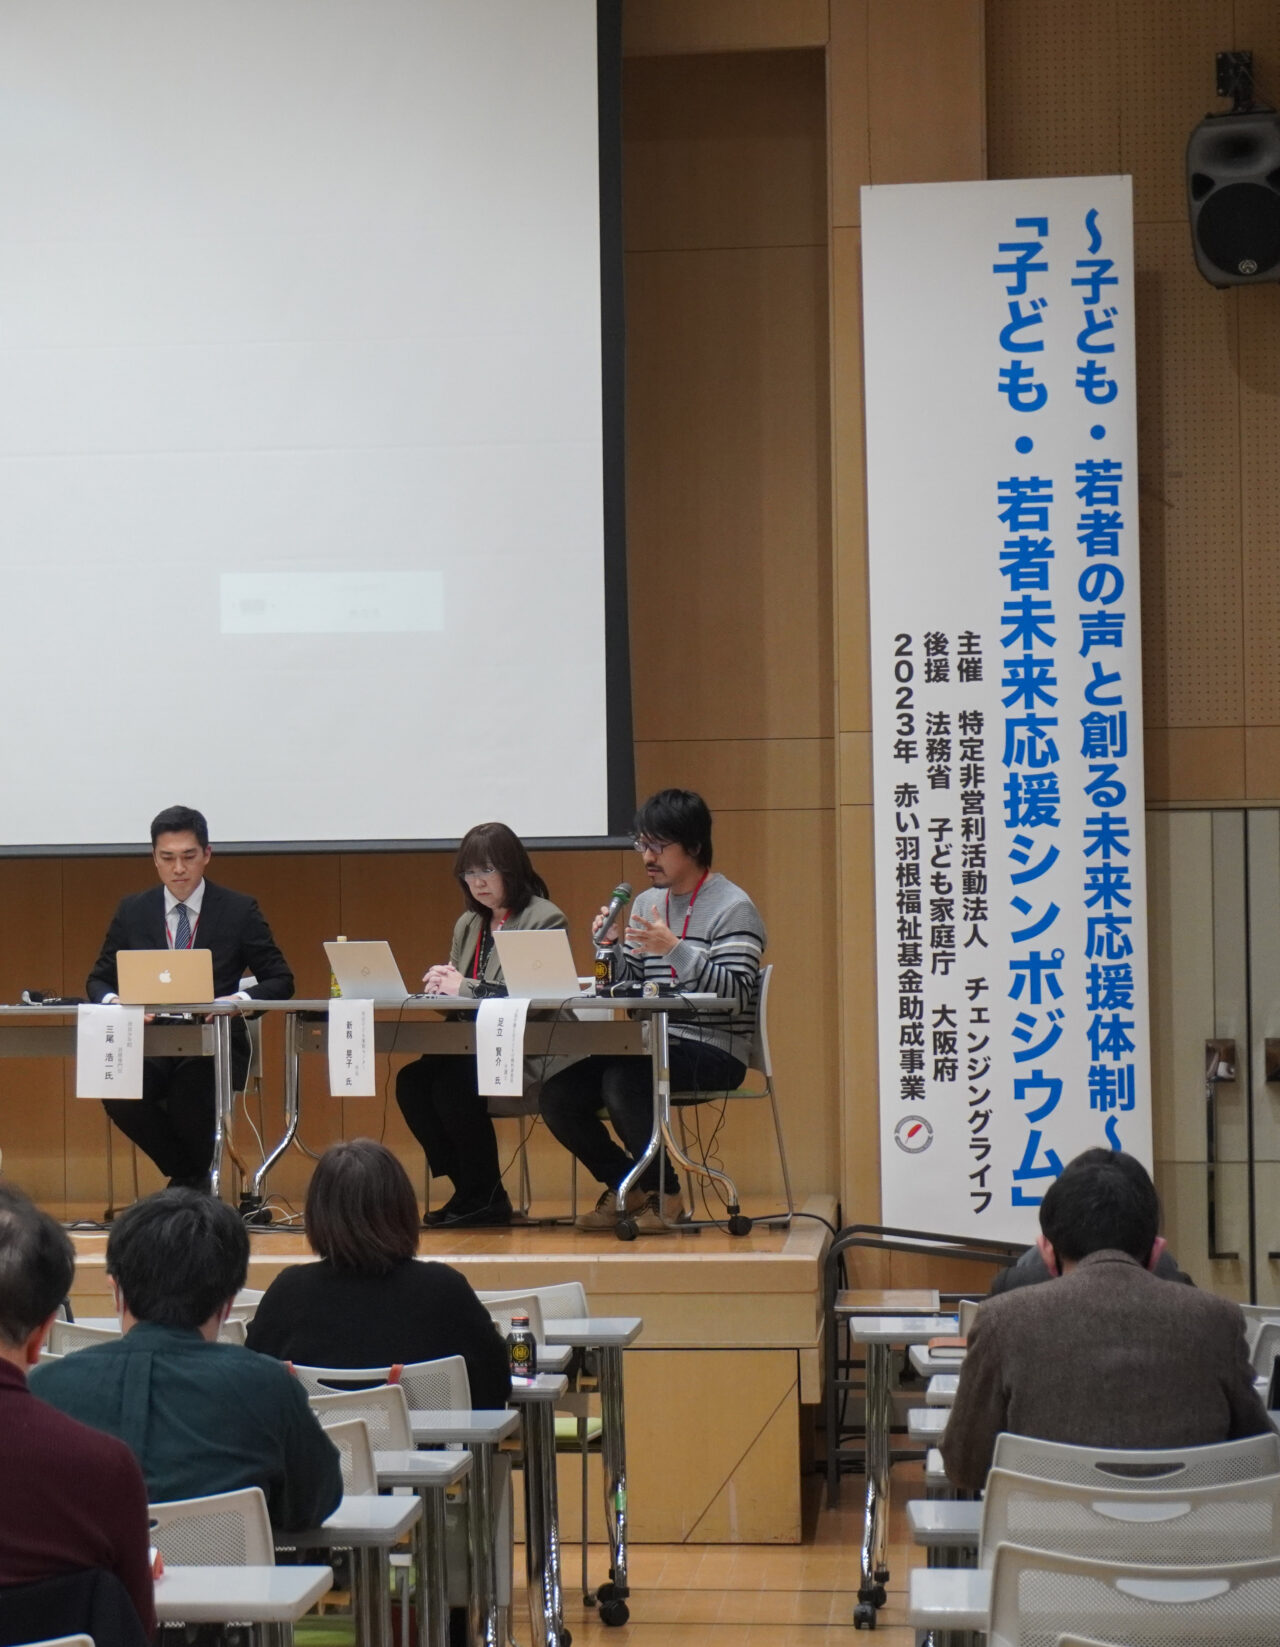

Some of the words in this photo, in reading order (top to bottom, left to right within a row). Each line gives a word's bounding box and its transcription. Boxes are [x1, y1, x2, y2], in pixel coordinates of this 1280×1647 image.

[893, 633, 919, 764] 2023年
[923, 631, 950, 684] 後援
[956, 630, 983, 683] 主催
[992, 216, 1065, 1207] 「子ども・若者未来応援シンポジウム」
[925, 710, 952, 790] 法務省
[927, 817, 956, 976] 子ども家庭庁
[958, 710, 988, 948] 特定非営利活動法人
[894, 782, 926, 1101] 赤い羽根福祉基金助成事業
[931, 1004, 959, 1082] 大阪府
[964, 977, 993, 1215] チェンジングライフ
